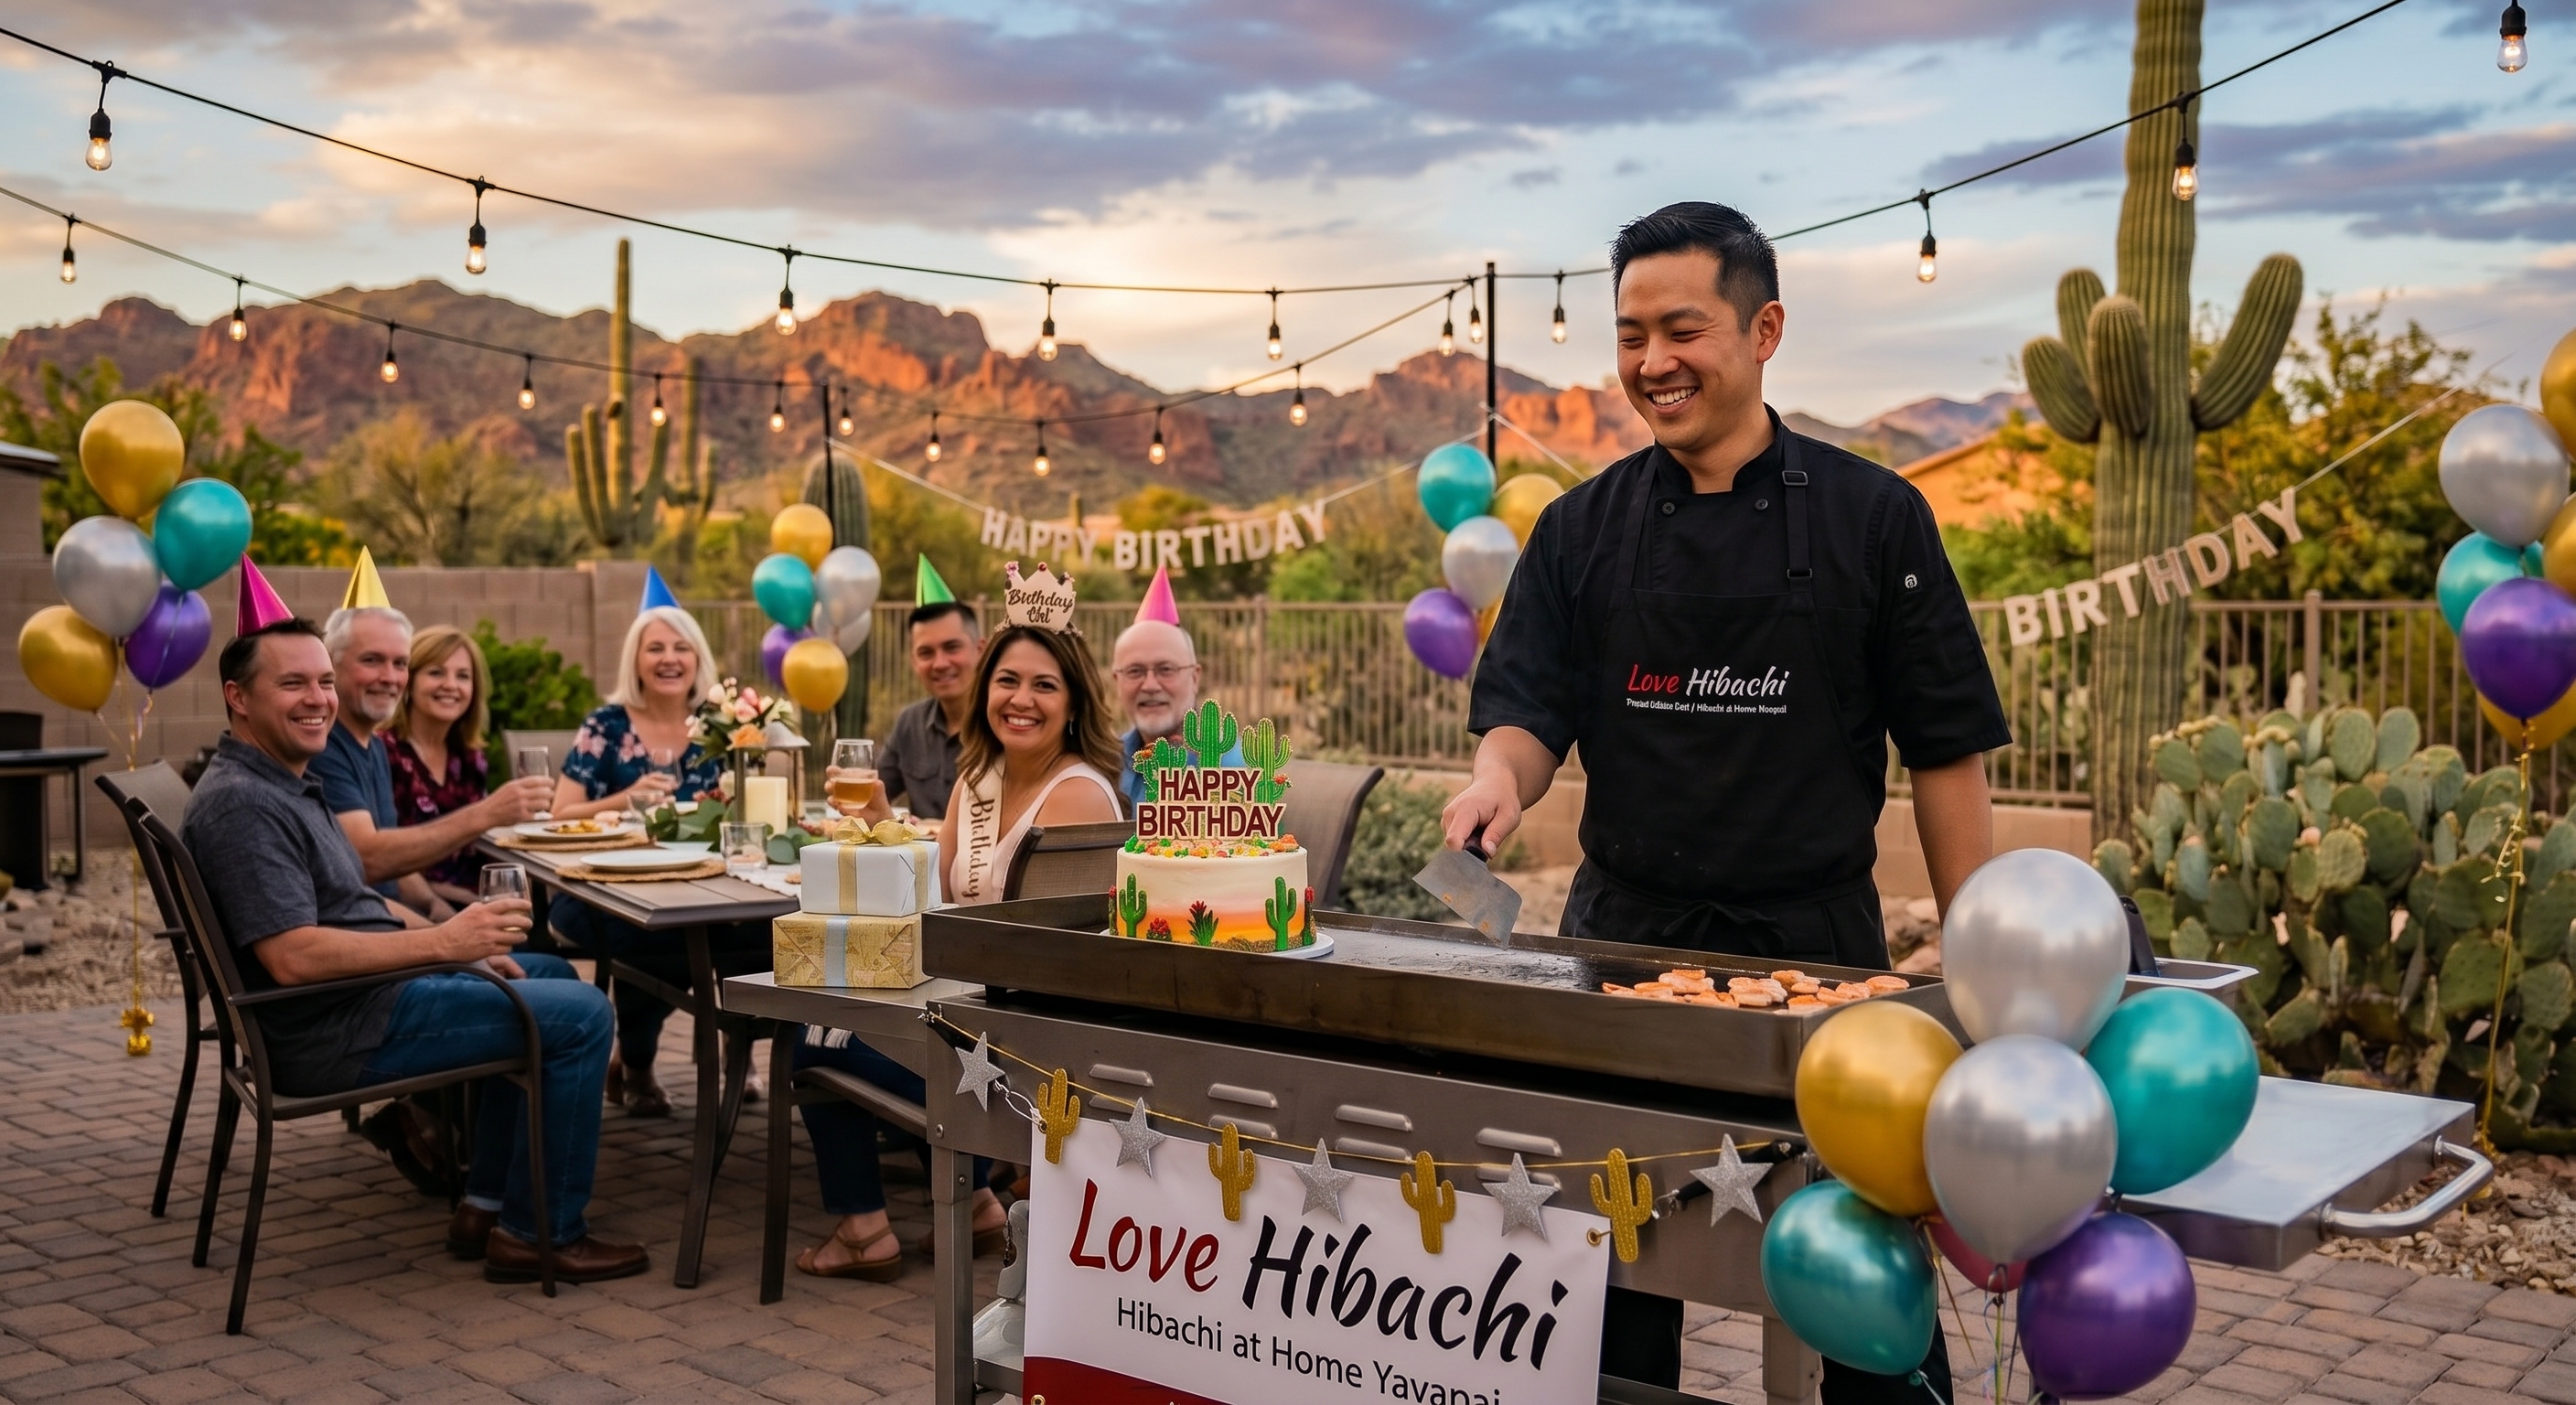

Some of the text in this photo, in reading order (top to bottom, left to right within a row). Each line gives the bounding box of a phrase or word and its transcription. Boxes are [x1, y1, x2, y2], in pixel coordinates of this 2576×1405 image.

[980, 499, 1326, 570] HAPPY BIRTHDAY
[2002, 486, 2303, 647] BIRTHDAY
[1627, 664, 1790, 697] Love Hibachi
[1160, 769, 1261, 801] HAPPY
[1138, 805, 1284, 838] BIRTHDAY
[1069, 1177, 1569, 1371] Love Hibachi
[1116, 1297, 1223, 1352] Hibachi
[1232, 1331, 1261, 1363] at
[1272, 1336, 1363, 1389] Home
